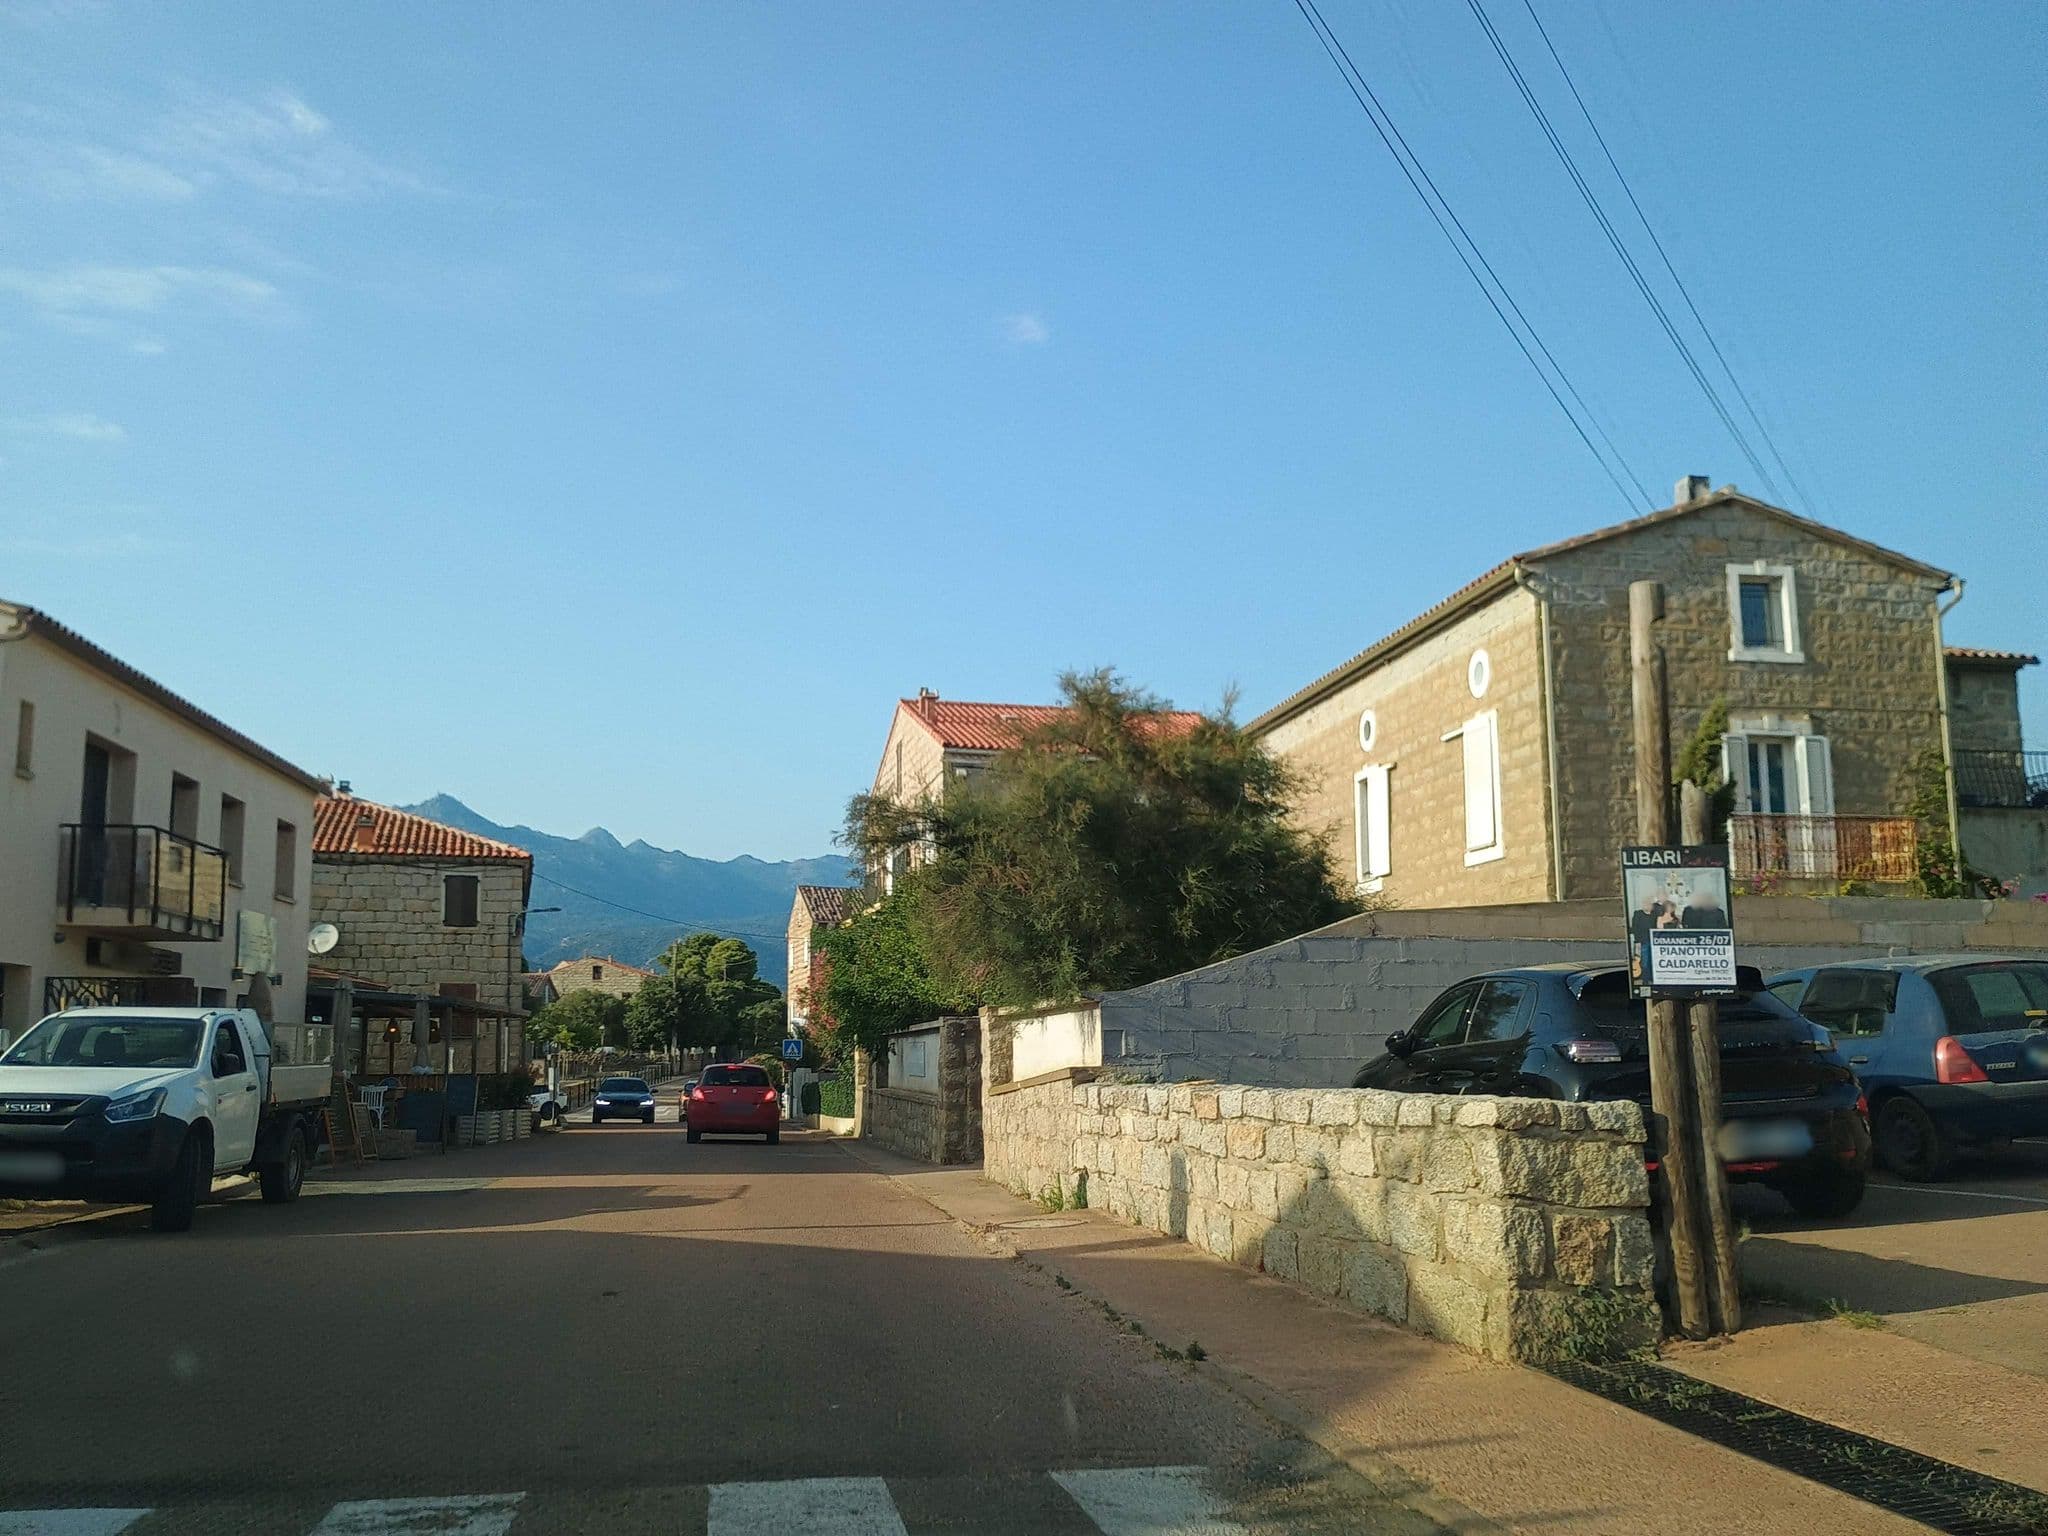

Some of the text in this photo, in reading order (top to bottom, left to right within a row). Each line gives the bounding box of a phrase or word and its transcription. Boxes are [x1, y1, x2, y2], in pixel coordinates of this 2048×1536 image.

[1622, 850, 1681, 866] LIBARI
[1653, 935, 1729, 946] DIMANCHE 26/07
[1659, 947, 1726, 956] PIANOTTOLI
[1658, 959, 1729, 969] CALDARELLO
[4, 1103, 51, 1112] ISUZU
